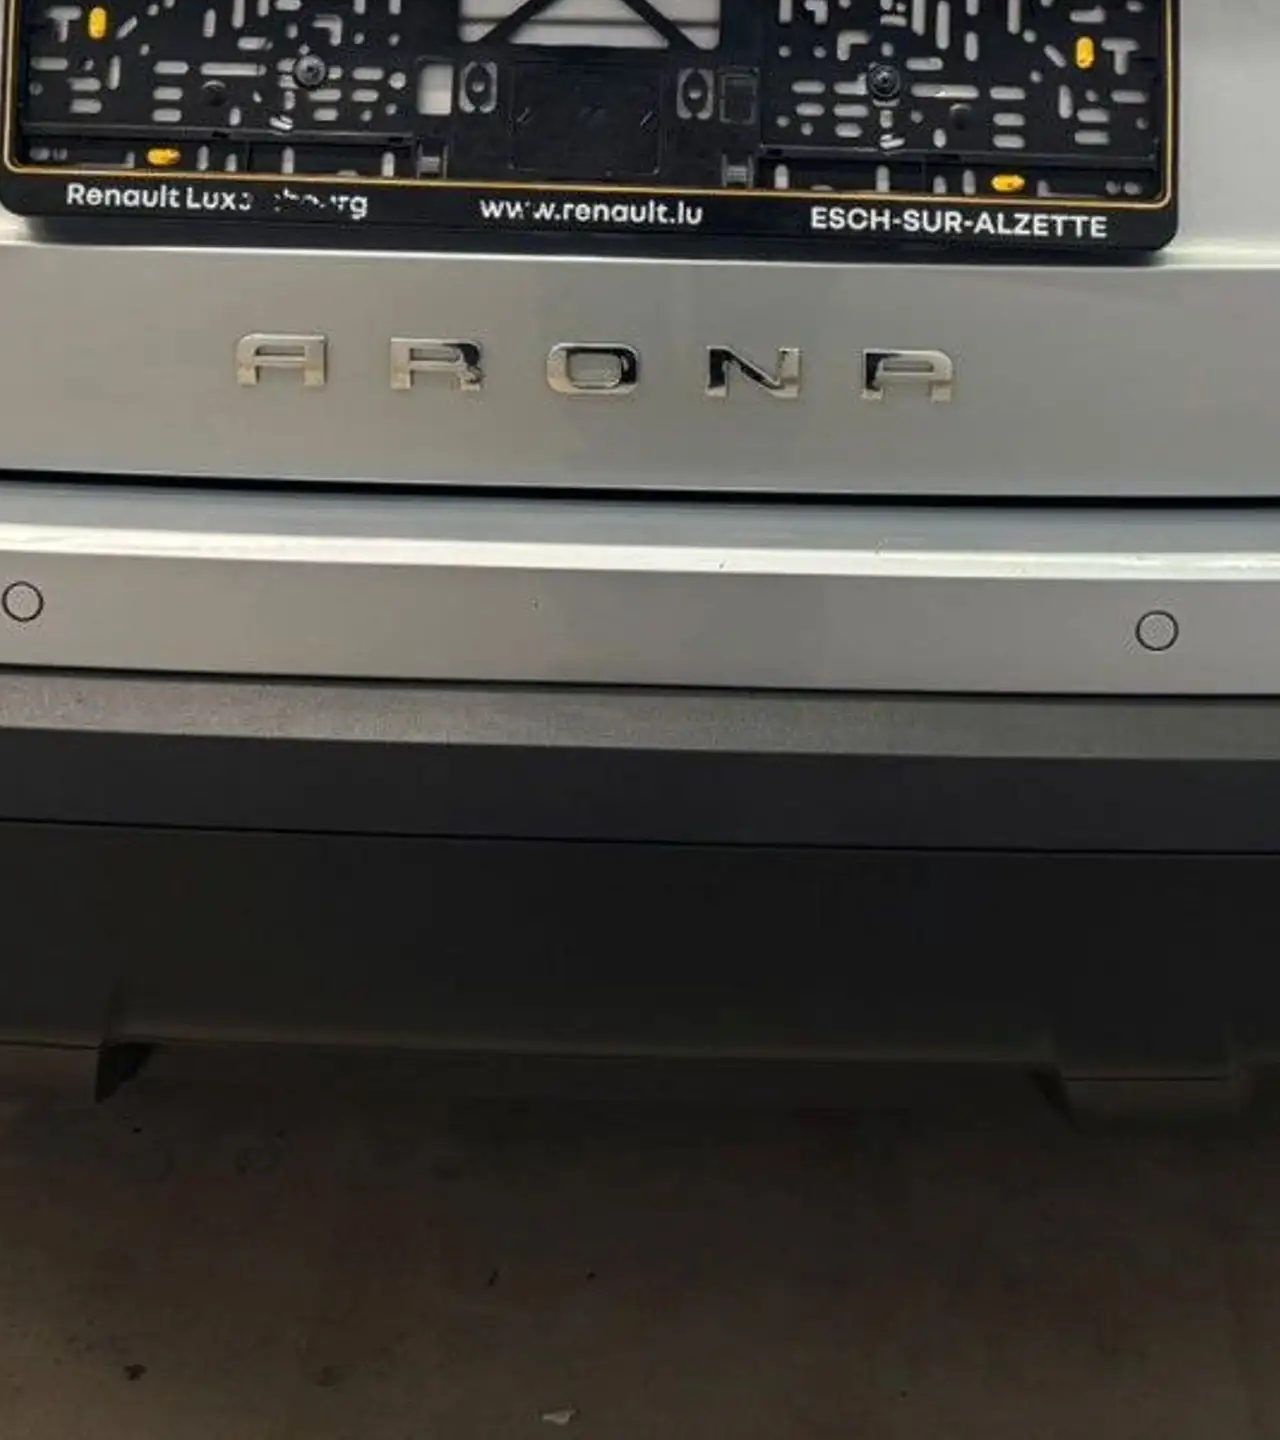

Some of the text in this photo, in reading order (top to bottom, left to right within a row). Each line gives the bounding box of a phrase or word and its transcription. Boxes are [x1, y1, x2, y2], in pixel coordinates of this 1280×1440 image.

[66, 182, 369, 220] Renault Luxrg
[809, 206, 1108, 239] ESCH-SUR-ALZETTE
[236, 332, 955, 402] ARONA
